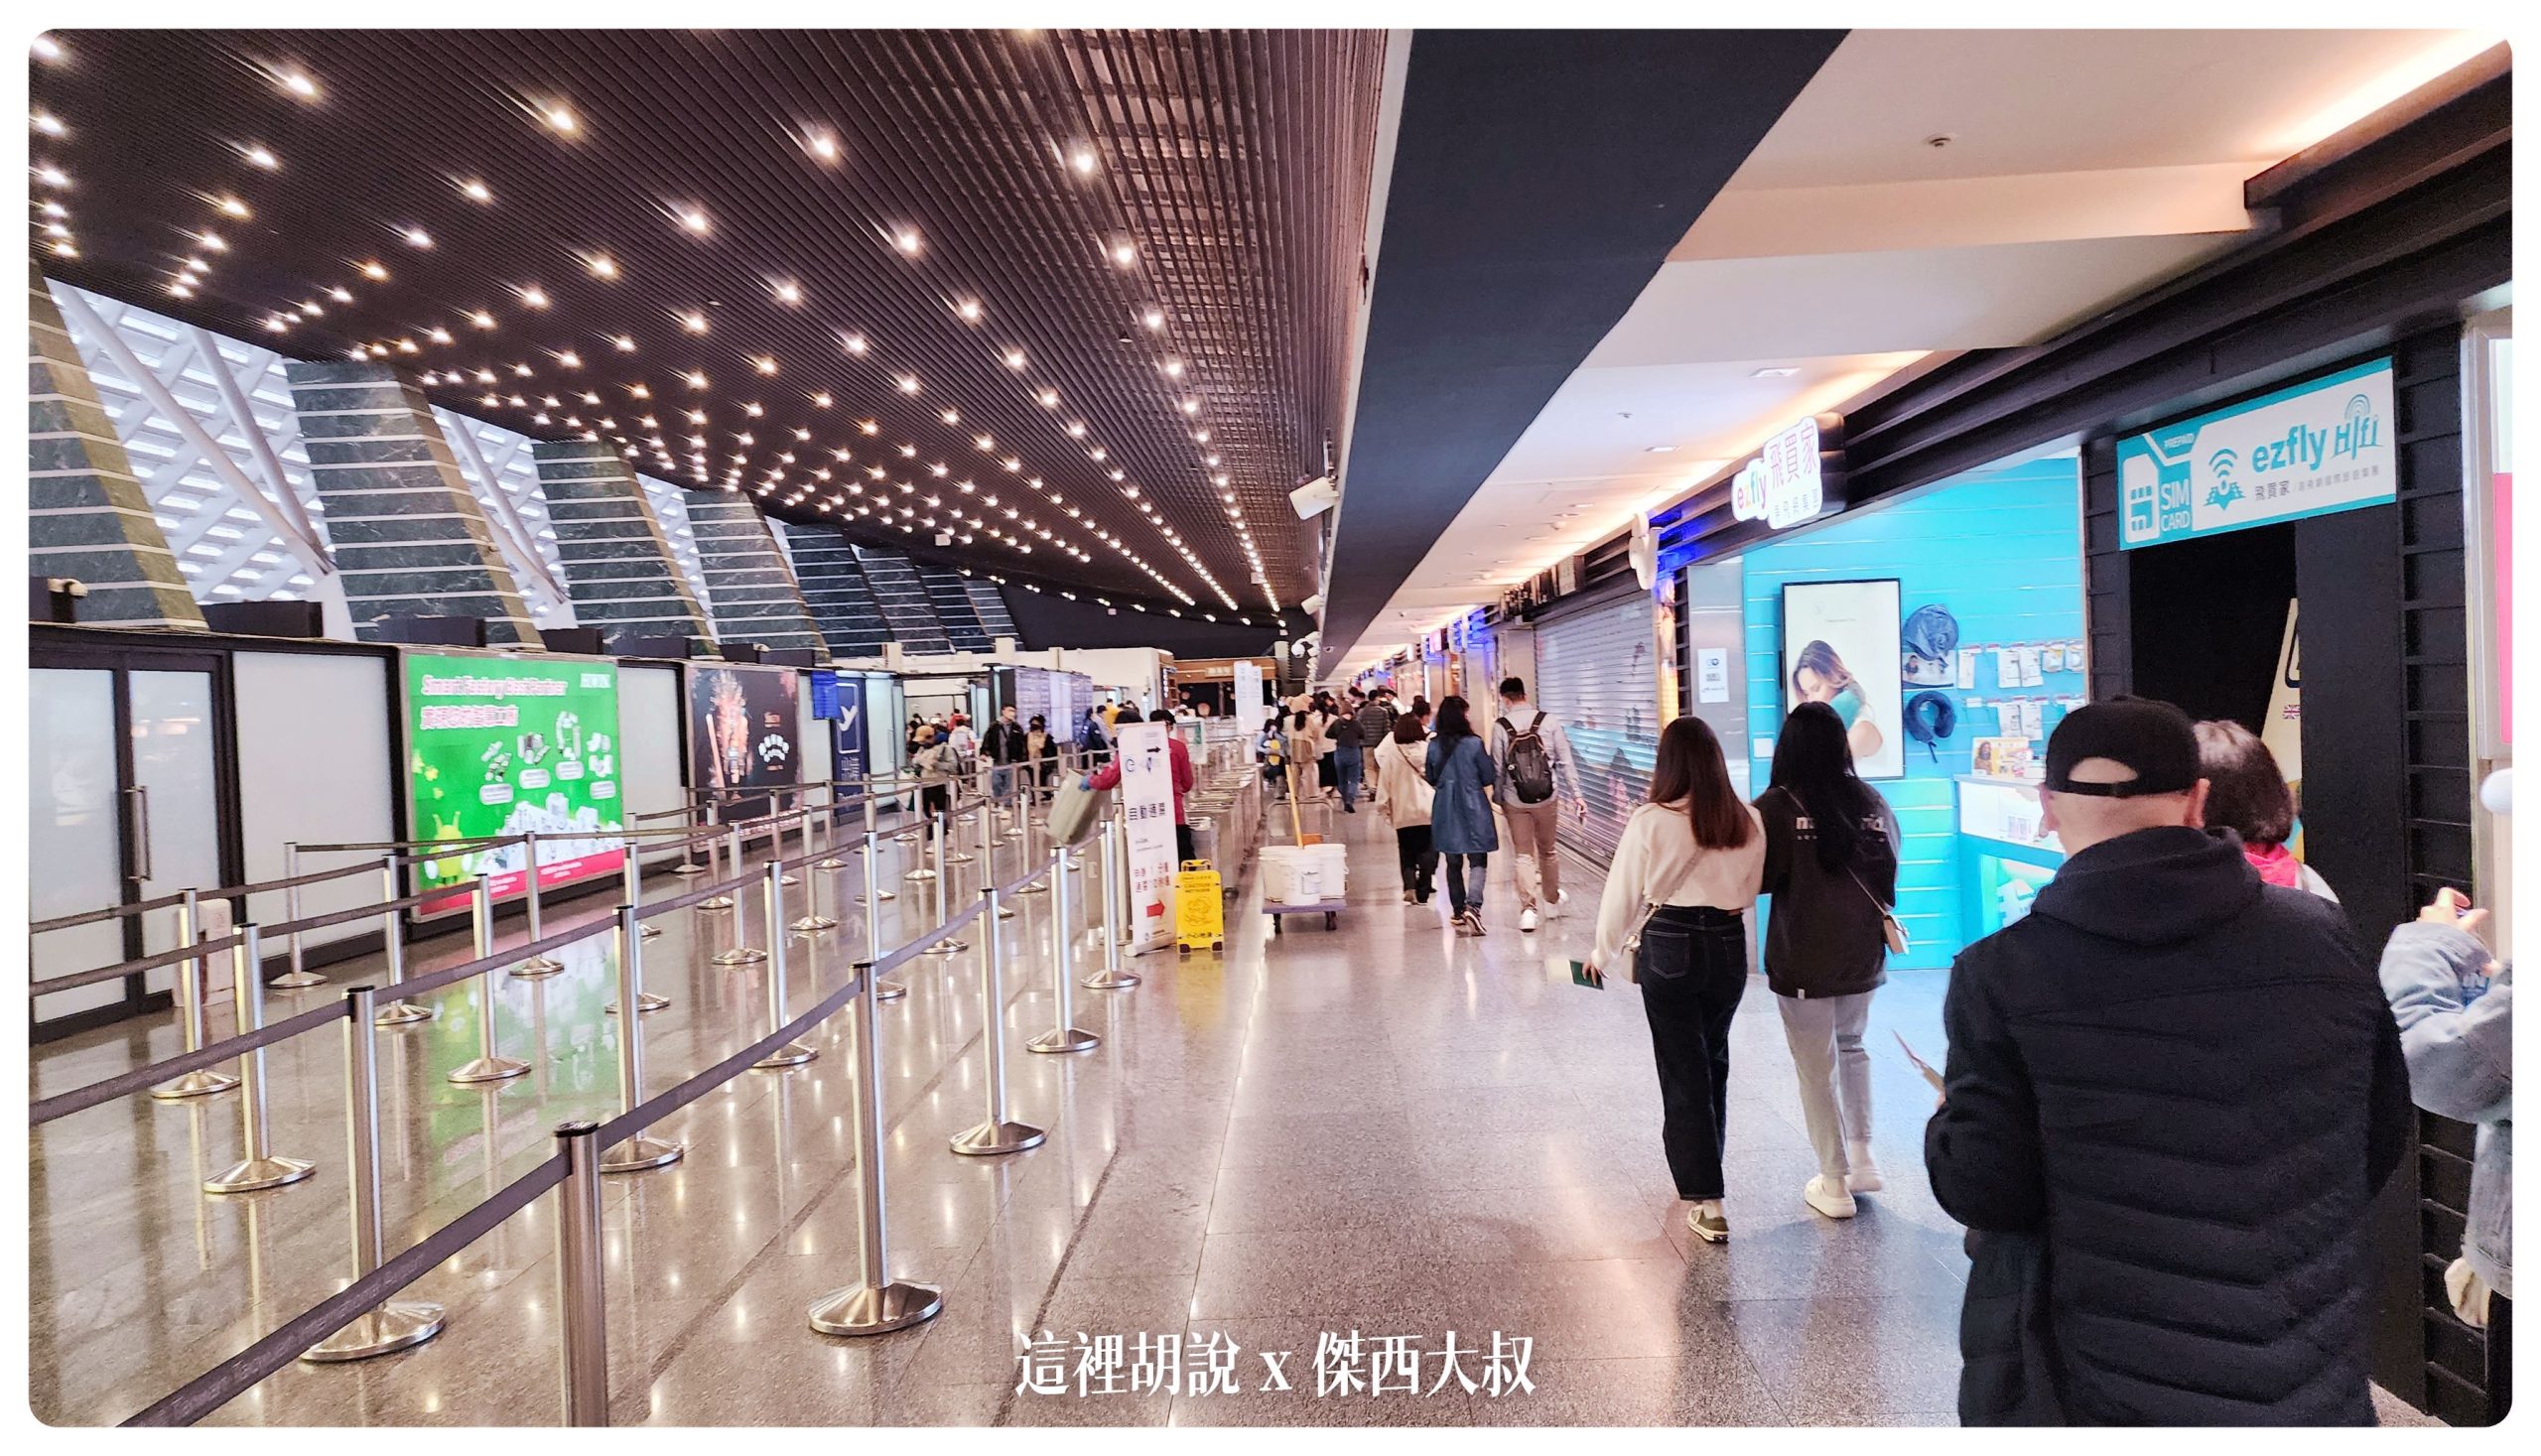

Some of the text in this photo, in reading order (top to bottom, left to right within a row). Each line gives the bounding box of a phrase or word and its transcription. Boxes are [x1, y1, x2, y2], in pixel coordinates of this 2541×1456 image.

[1770, 424, 1818, 490] 飛買家
[2252, 424, 2328, 472] ezfly
[1737, 470, 1768, 510] ezfly
[2161, 478, 2191, 510] SIM
[2160, 510, 2191, 532] CARD
